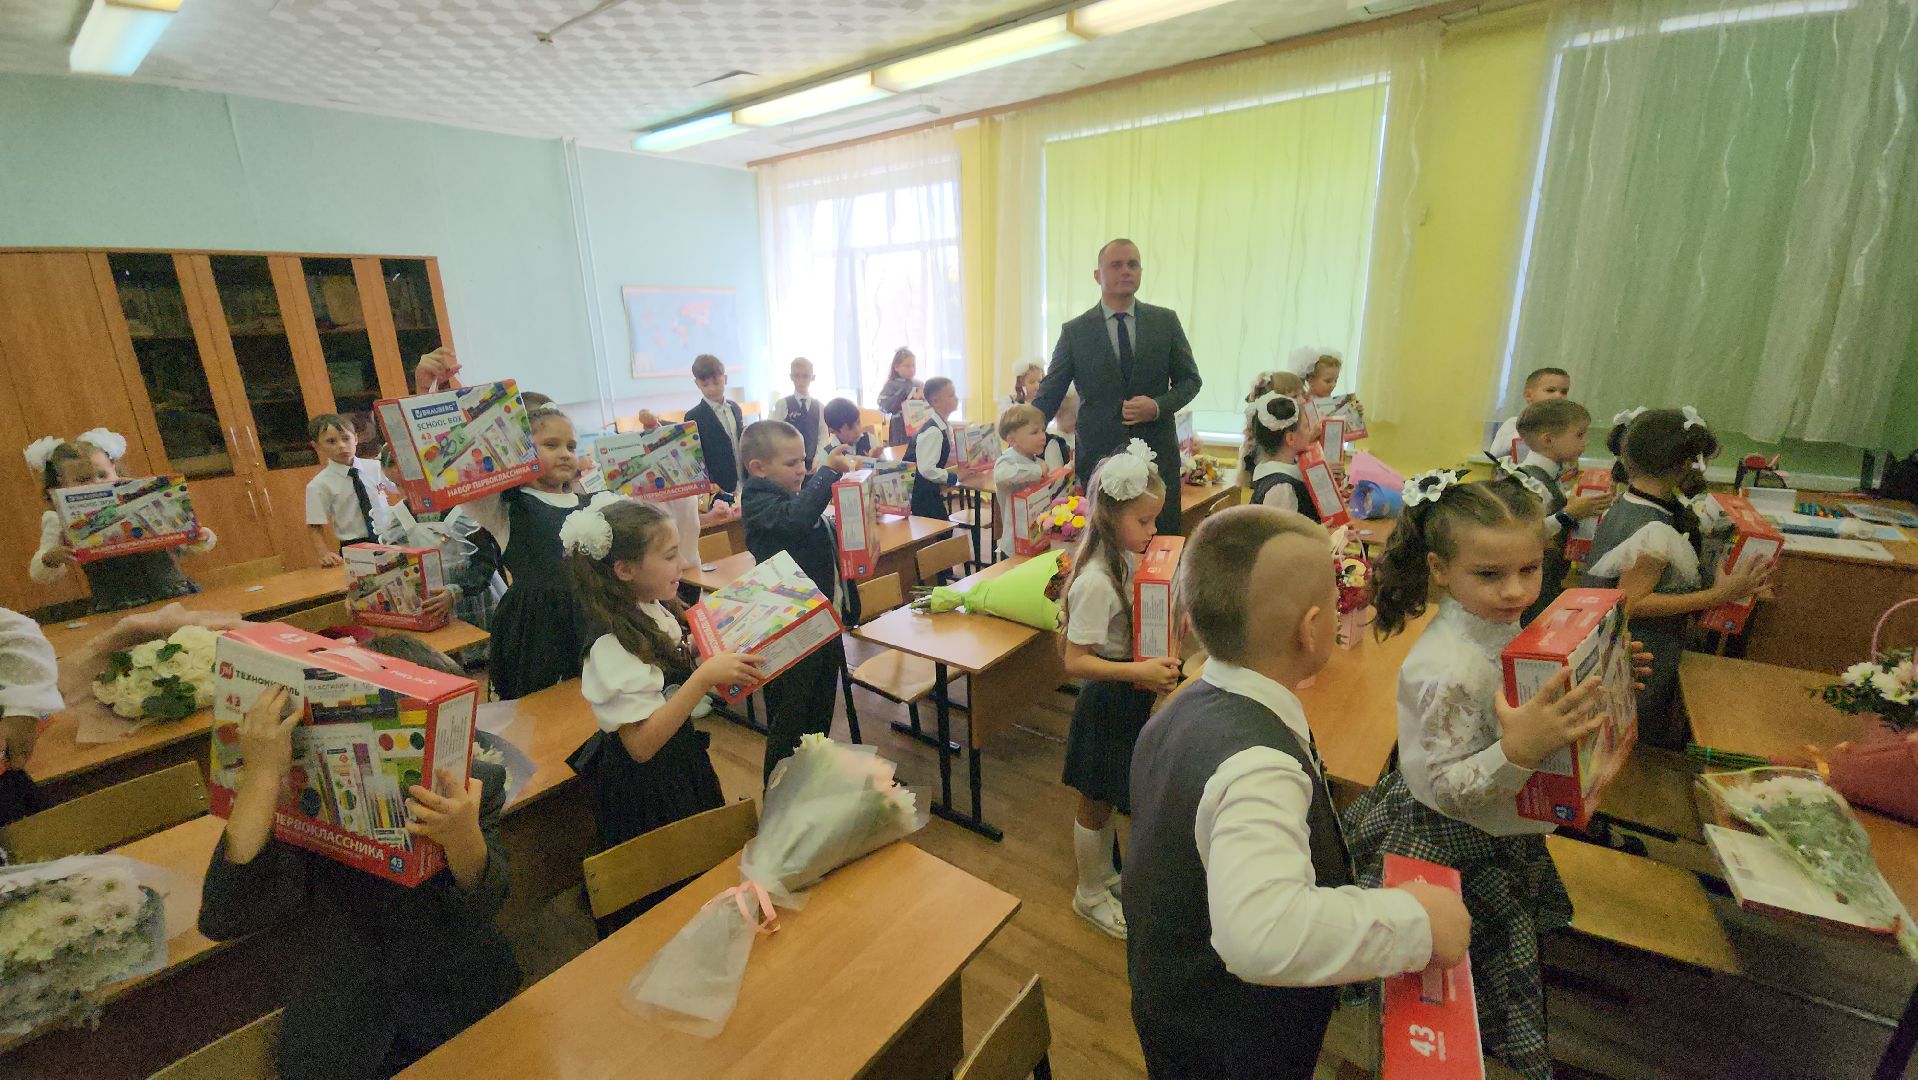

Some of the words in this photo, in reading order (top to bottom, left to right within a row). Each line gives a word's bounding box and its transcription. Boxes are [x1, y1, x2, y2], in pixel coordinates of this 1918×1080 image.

[422, 404, 454, 416] BRAUBERG
[416, 419, 447, 431] SCHOOL
[447, 415, 463, 424] BOX
[447, 484, 472, 497] НАБОР
[472, 465, 531, 490] ПЕРВОКЛАССНИКА
[391, 856, 403, 868] 43
[1409, 1024, 1436, 1057] 43
